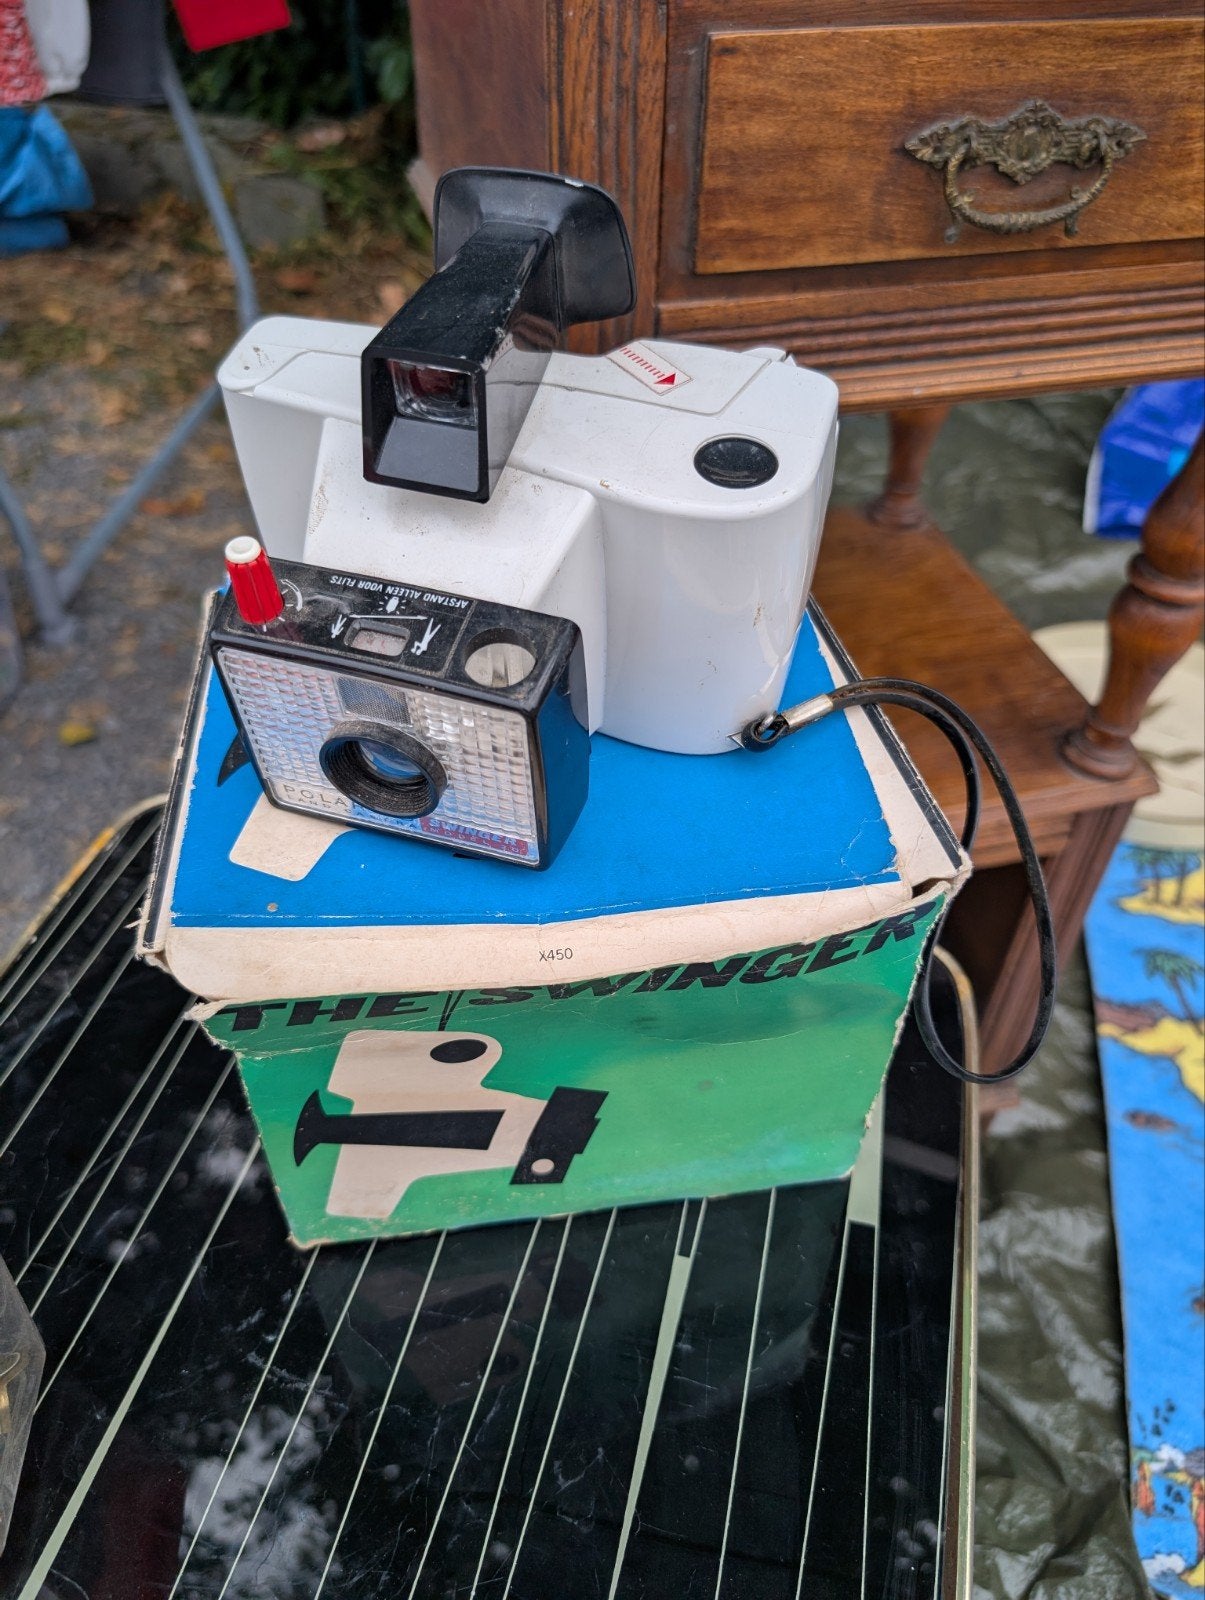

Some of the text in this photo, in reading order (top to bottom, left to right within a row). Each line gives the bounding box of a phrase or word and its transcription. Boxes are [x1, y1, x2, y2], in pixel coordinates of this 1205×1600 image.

[330, 575, 469, 609] AFSTAND ALLEEN VOOR FLITS
[428, 818, 518, 846] SWINGER
[214, 901, 937, 1032] THE SWINGER
[538, 947, 574, 962] X450
